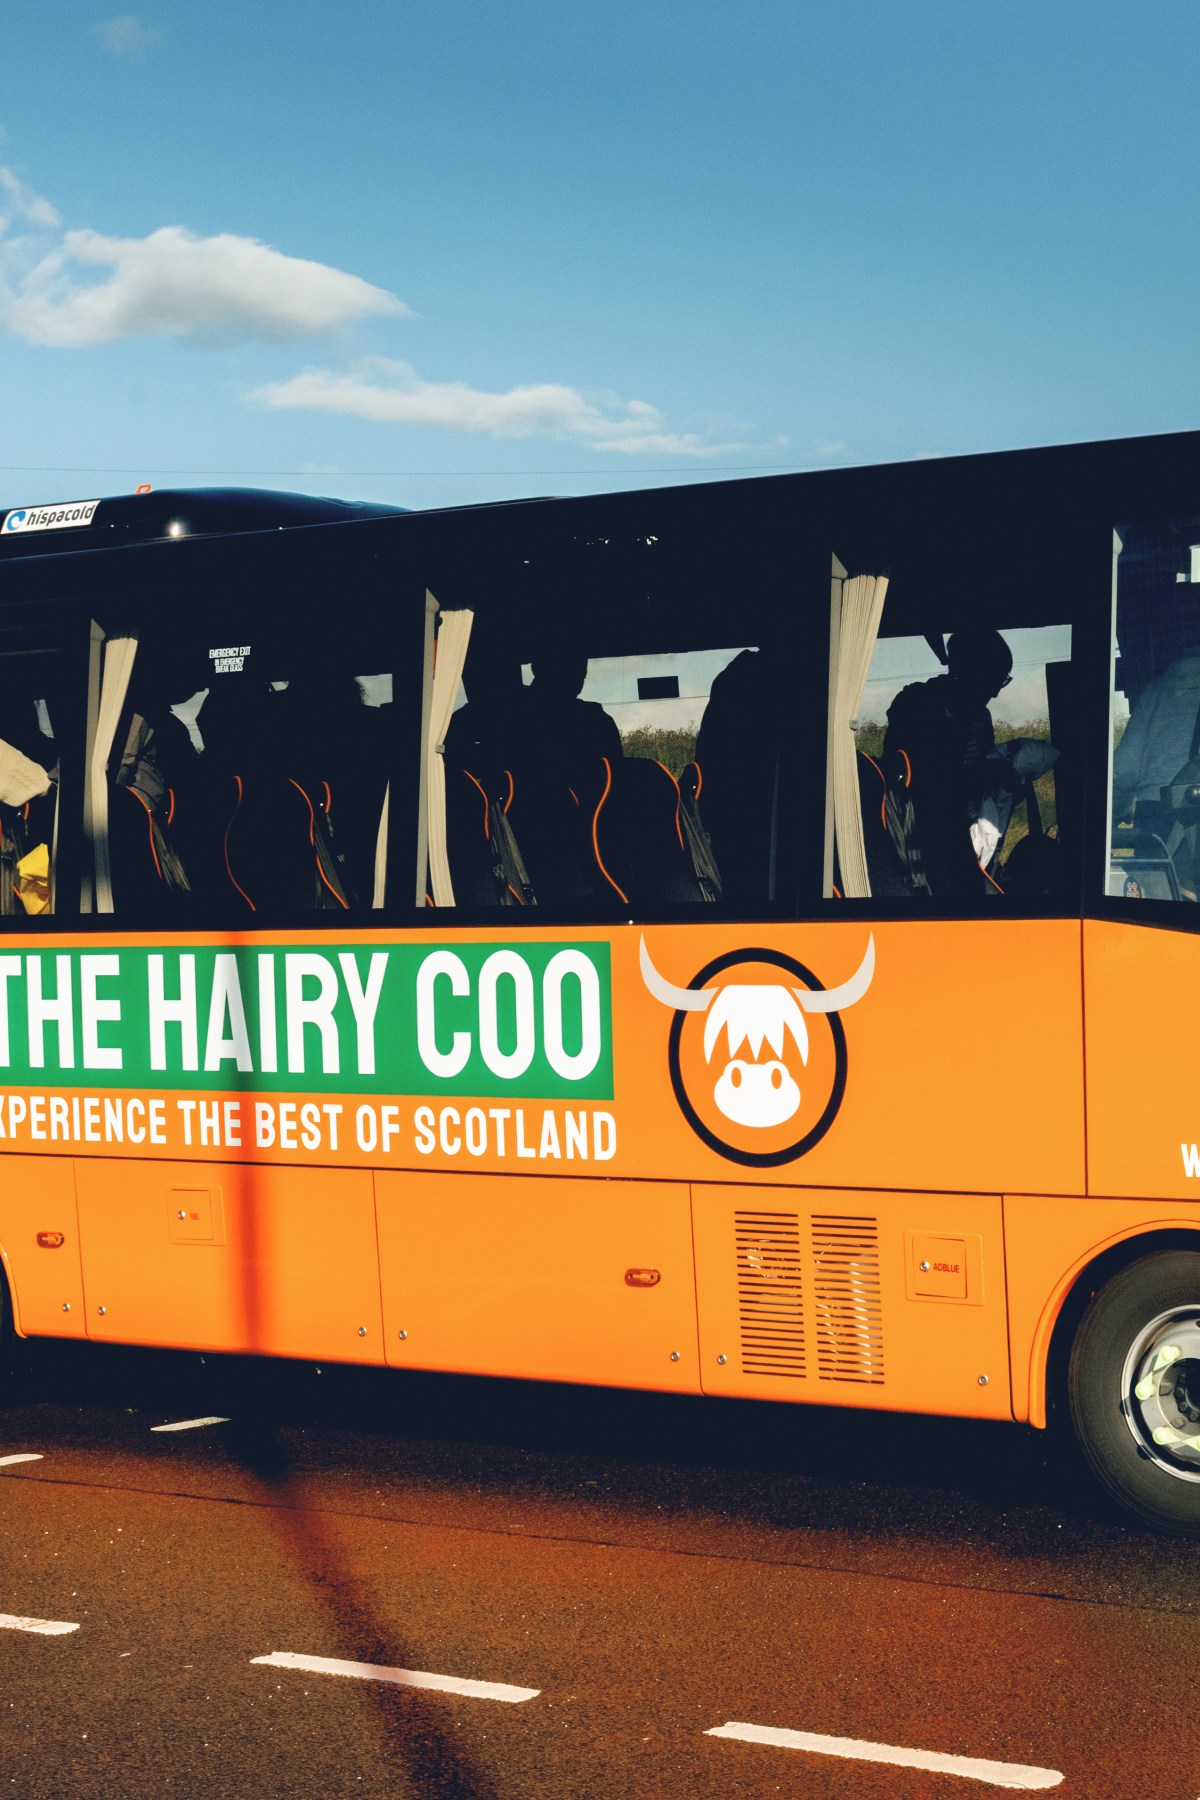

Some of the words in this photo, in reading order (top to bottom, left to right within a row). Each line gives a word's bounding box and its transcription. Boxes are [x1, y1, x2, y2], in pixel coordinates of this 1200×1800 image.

[27, 505, 95, 527] hispacold
[209, 647, 239, 658] EMERGENCY
[240, 646, 251, 656] EXIT
[0, 955, 122, 1069] THE
[148, 953, 389, 1074] HAIRY
[417, 949, 601, 1080] COO
[177, 1100, 241, 1146] THE
[255, 1103, 342, 1150] BEST
[356, 1105, 399, 1152] OF
[414, 1106, 616, 1160] SCOTLAND
[933, 1263, 960, 1273] ADBLUE
